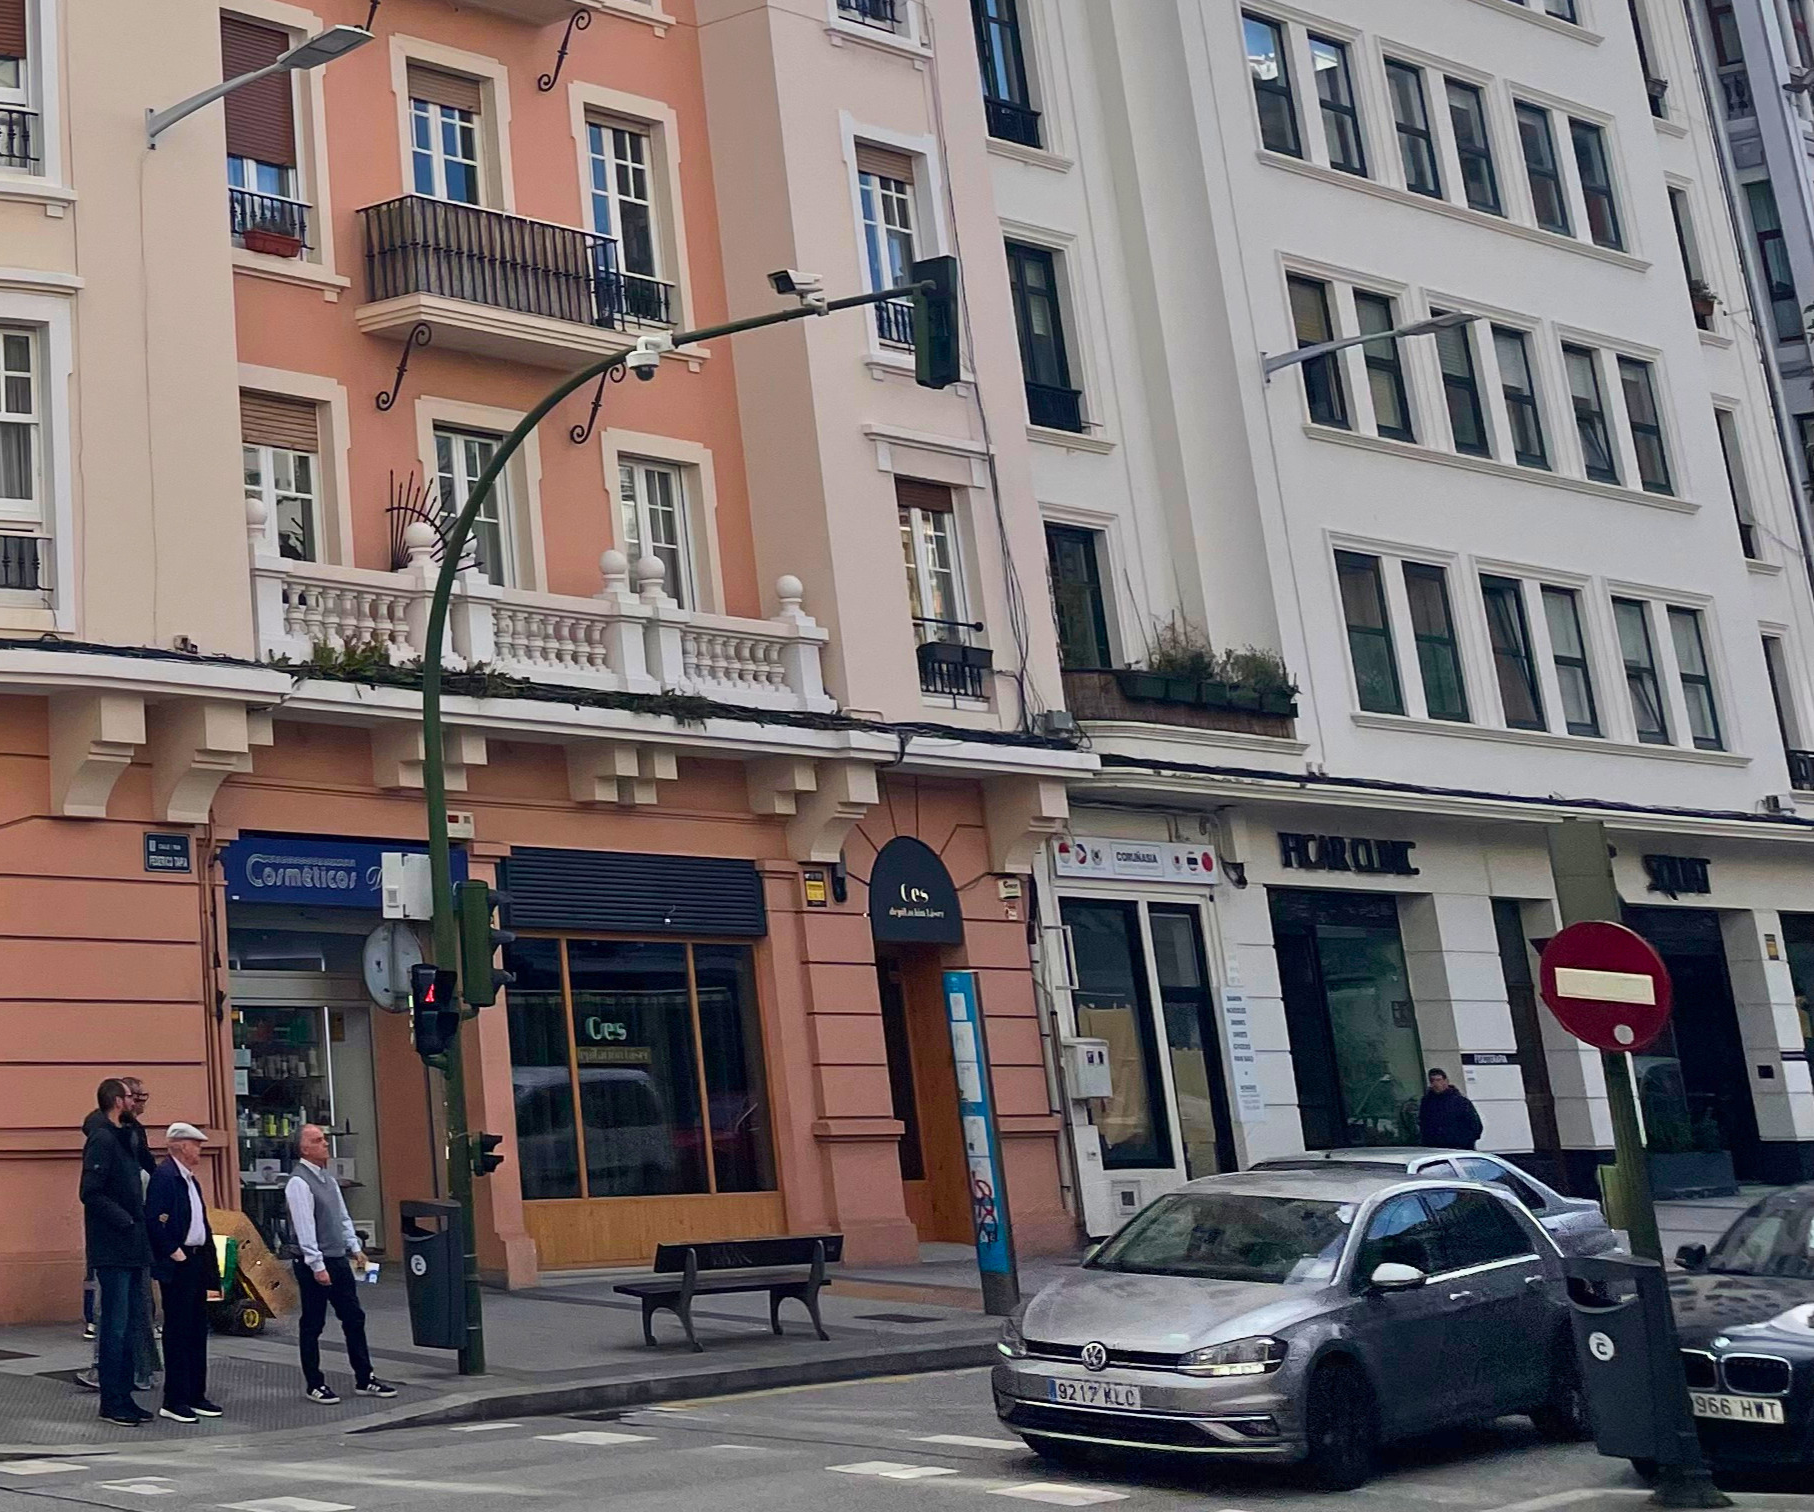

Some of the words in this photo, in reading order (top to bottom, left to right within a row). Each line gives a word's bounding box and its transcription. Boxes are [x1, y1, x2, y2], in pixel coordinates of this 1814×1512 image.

[1058, 1383, 1098, 1403] 9217
[1695, 1396, 1732, 1416] 966
[1740, 1399, 1777, 1421] HWT
